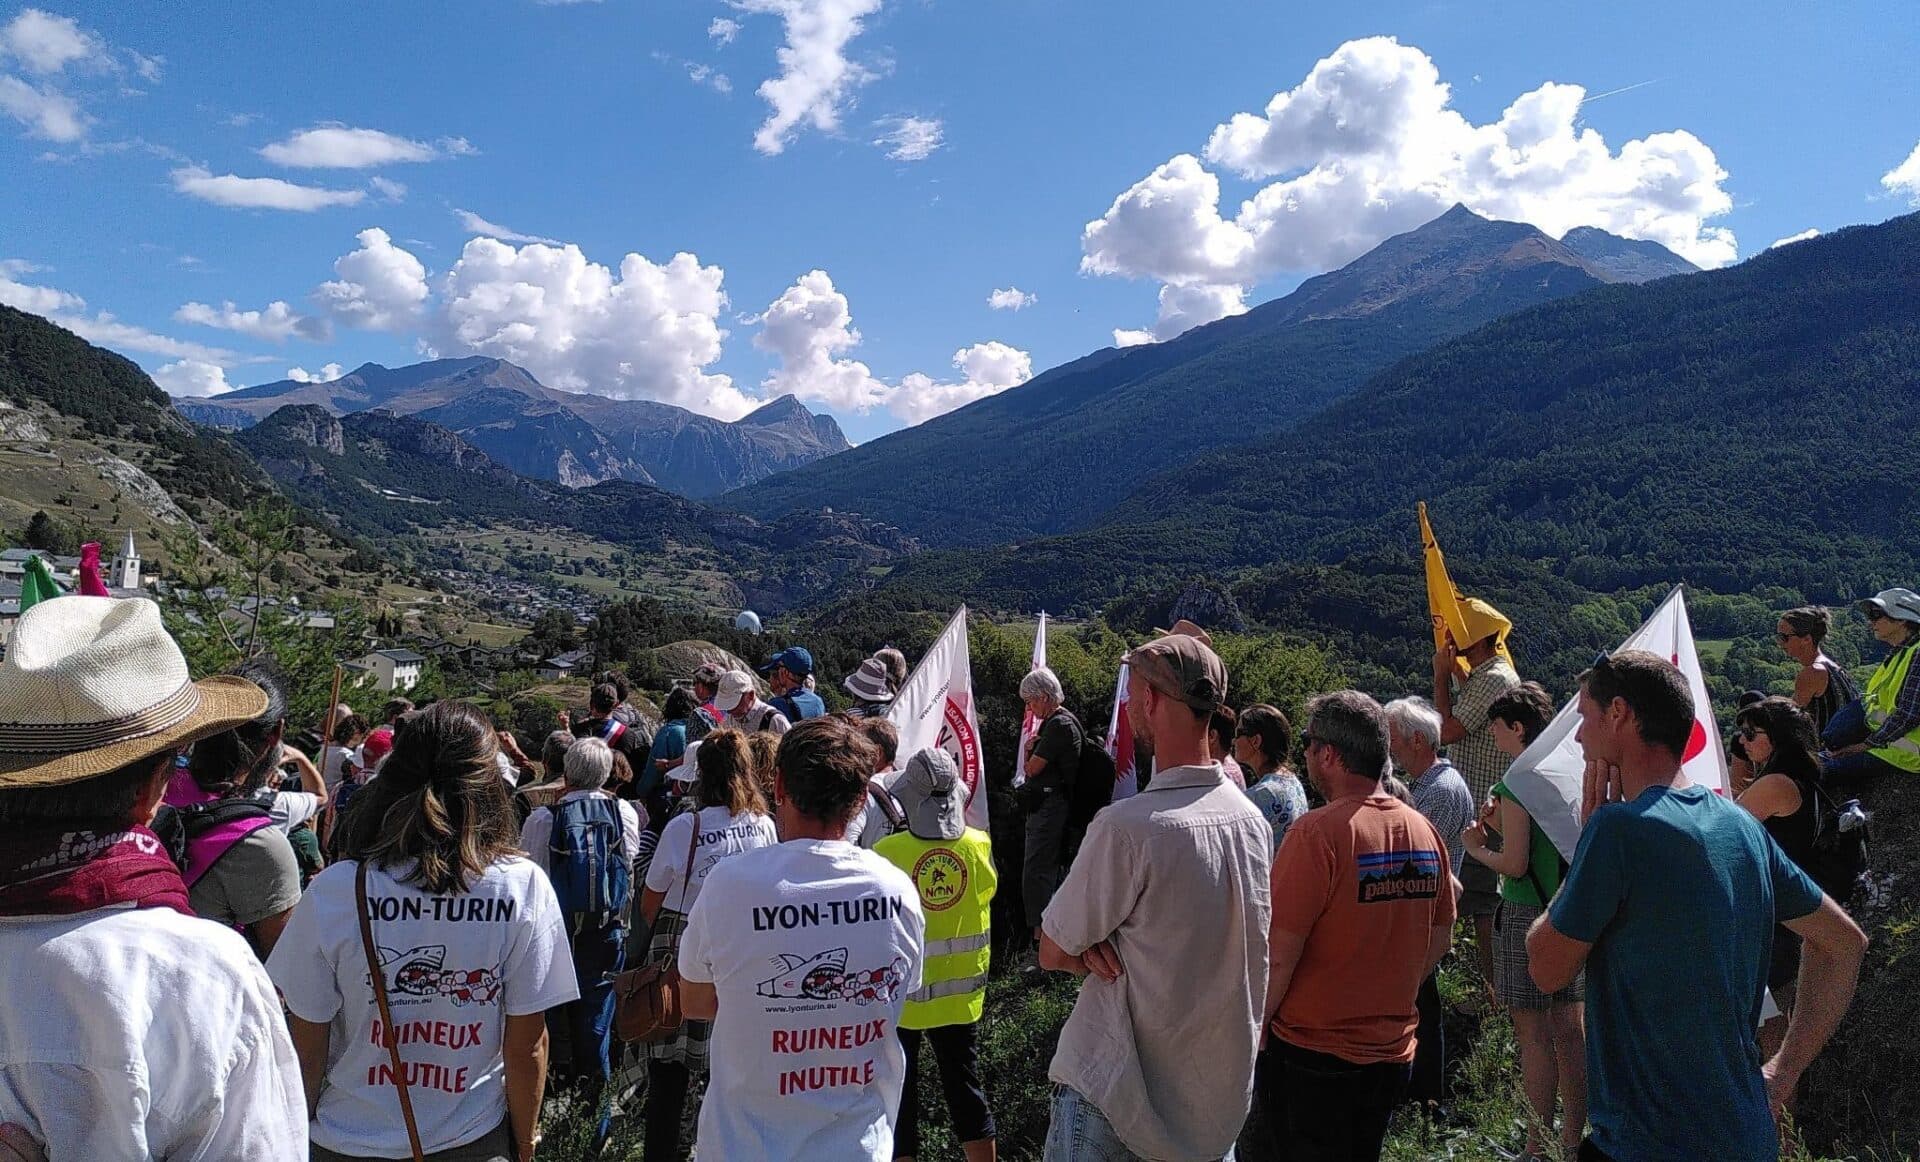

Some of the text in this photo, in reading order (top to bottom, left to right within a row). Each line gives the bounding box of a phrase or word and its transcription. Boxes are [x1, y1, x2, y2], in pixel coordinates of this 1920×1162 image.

[964, 743, 974, 761] DES
[965, 765, 976, 791] LIGN
[920, 856, 960, 876] LYON-TURIN
[367, 897, 515, 922] YON-TURIN
[753, 895, 902, 931] LYON-TURIN
[765, 1002, 837, 1014] www.lyonturin.eu
[772, 1019, 887, 1053] RUINEUX
[368, 1062, 468, 1093] INUTILE
[780, 1060, 874, 1095] INUTILE
